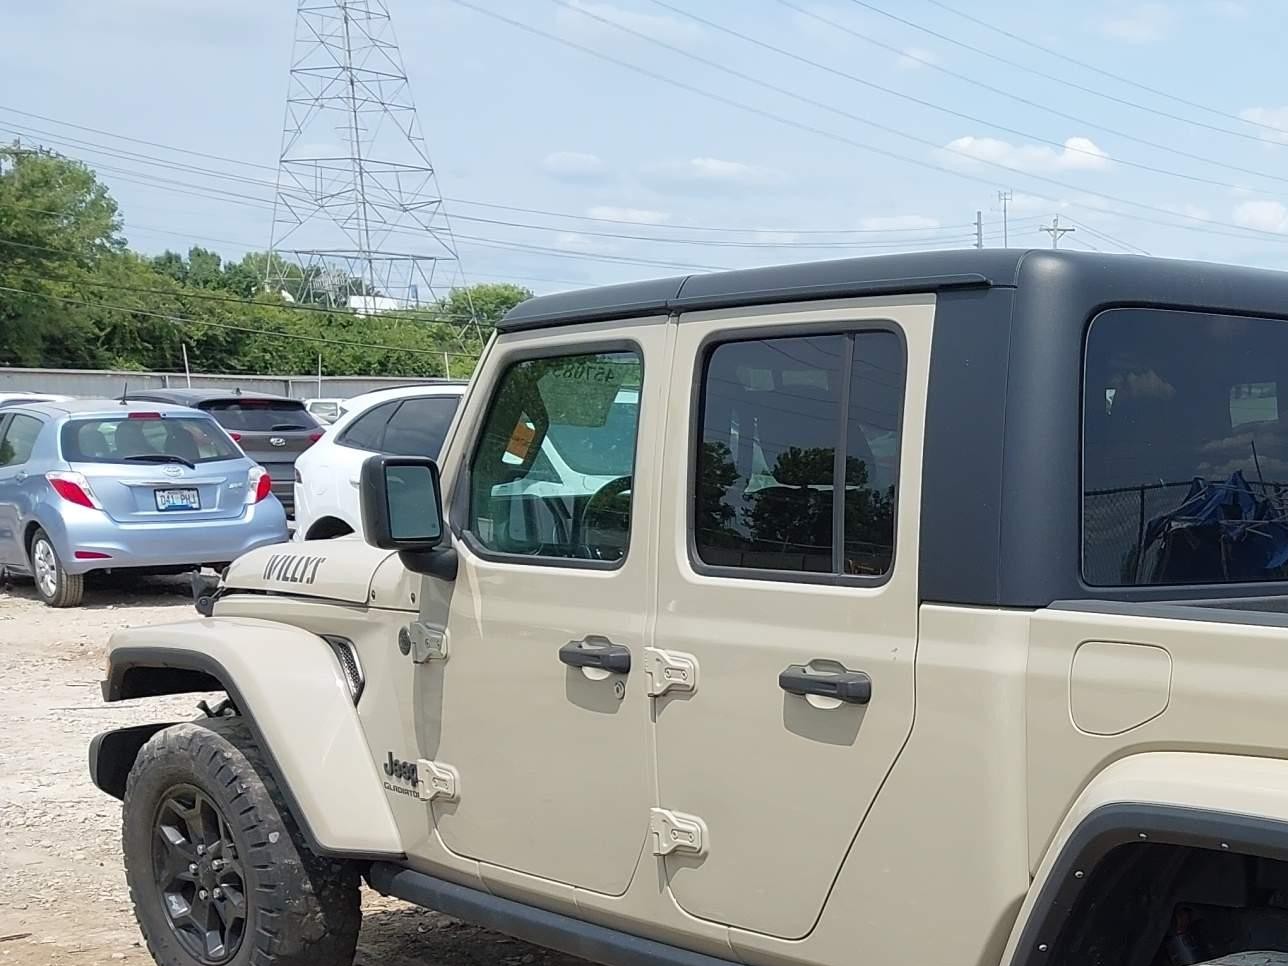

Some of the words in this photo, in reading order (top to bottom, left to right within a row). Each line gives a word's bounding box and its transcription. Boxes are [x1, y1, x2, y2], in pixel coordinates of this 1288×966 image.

[263, 554, 327, 584] WILLYS
[384, 751, 418, 787] Jeep
[384, 781, 420, 798] GLADIATO
